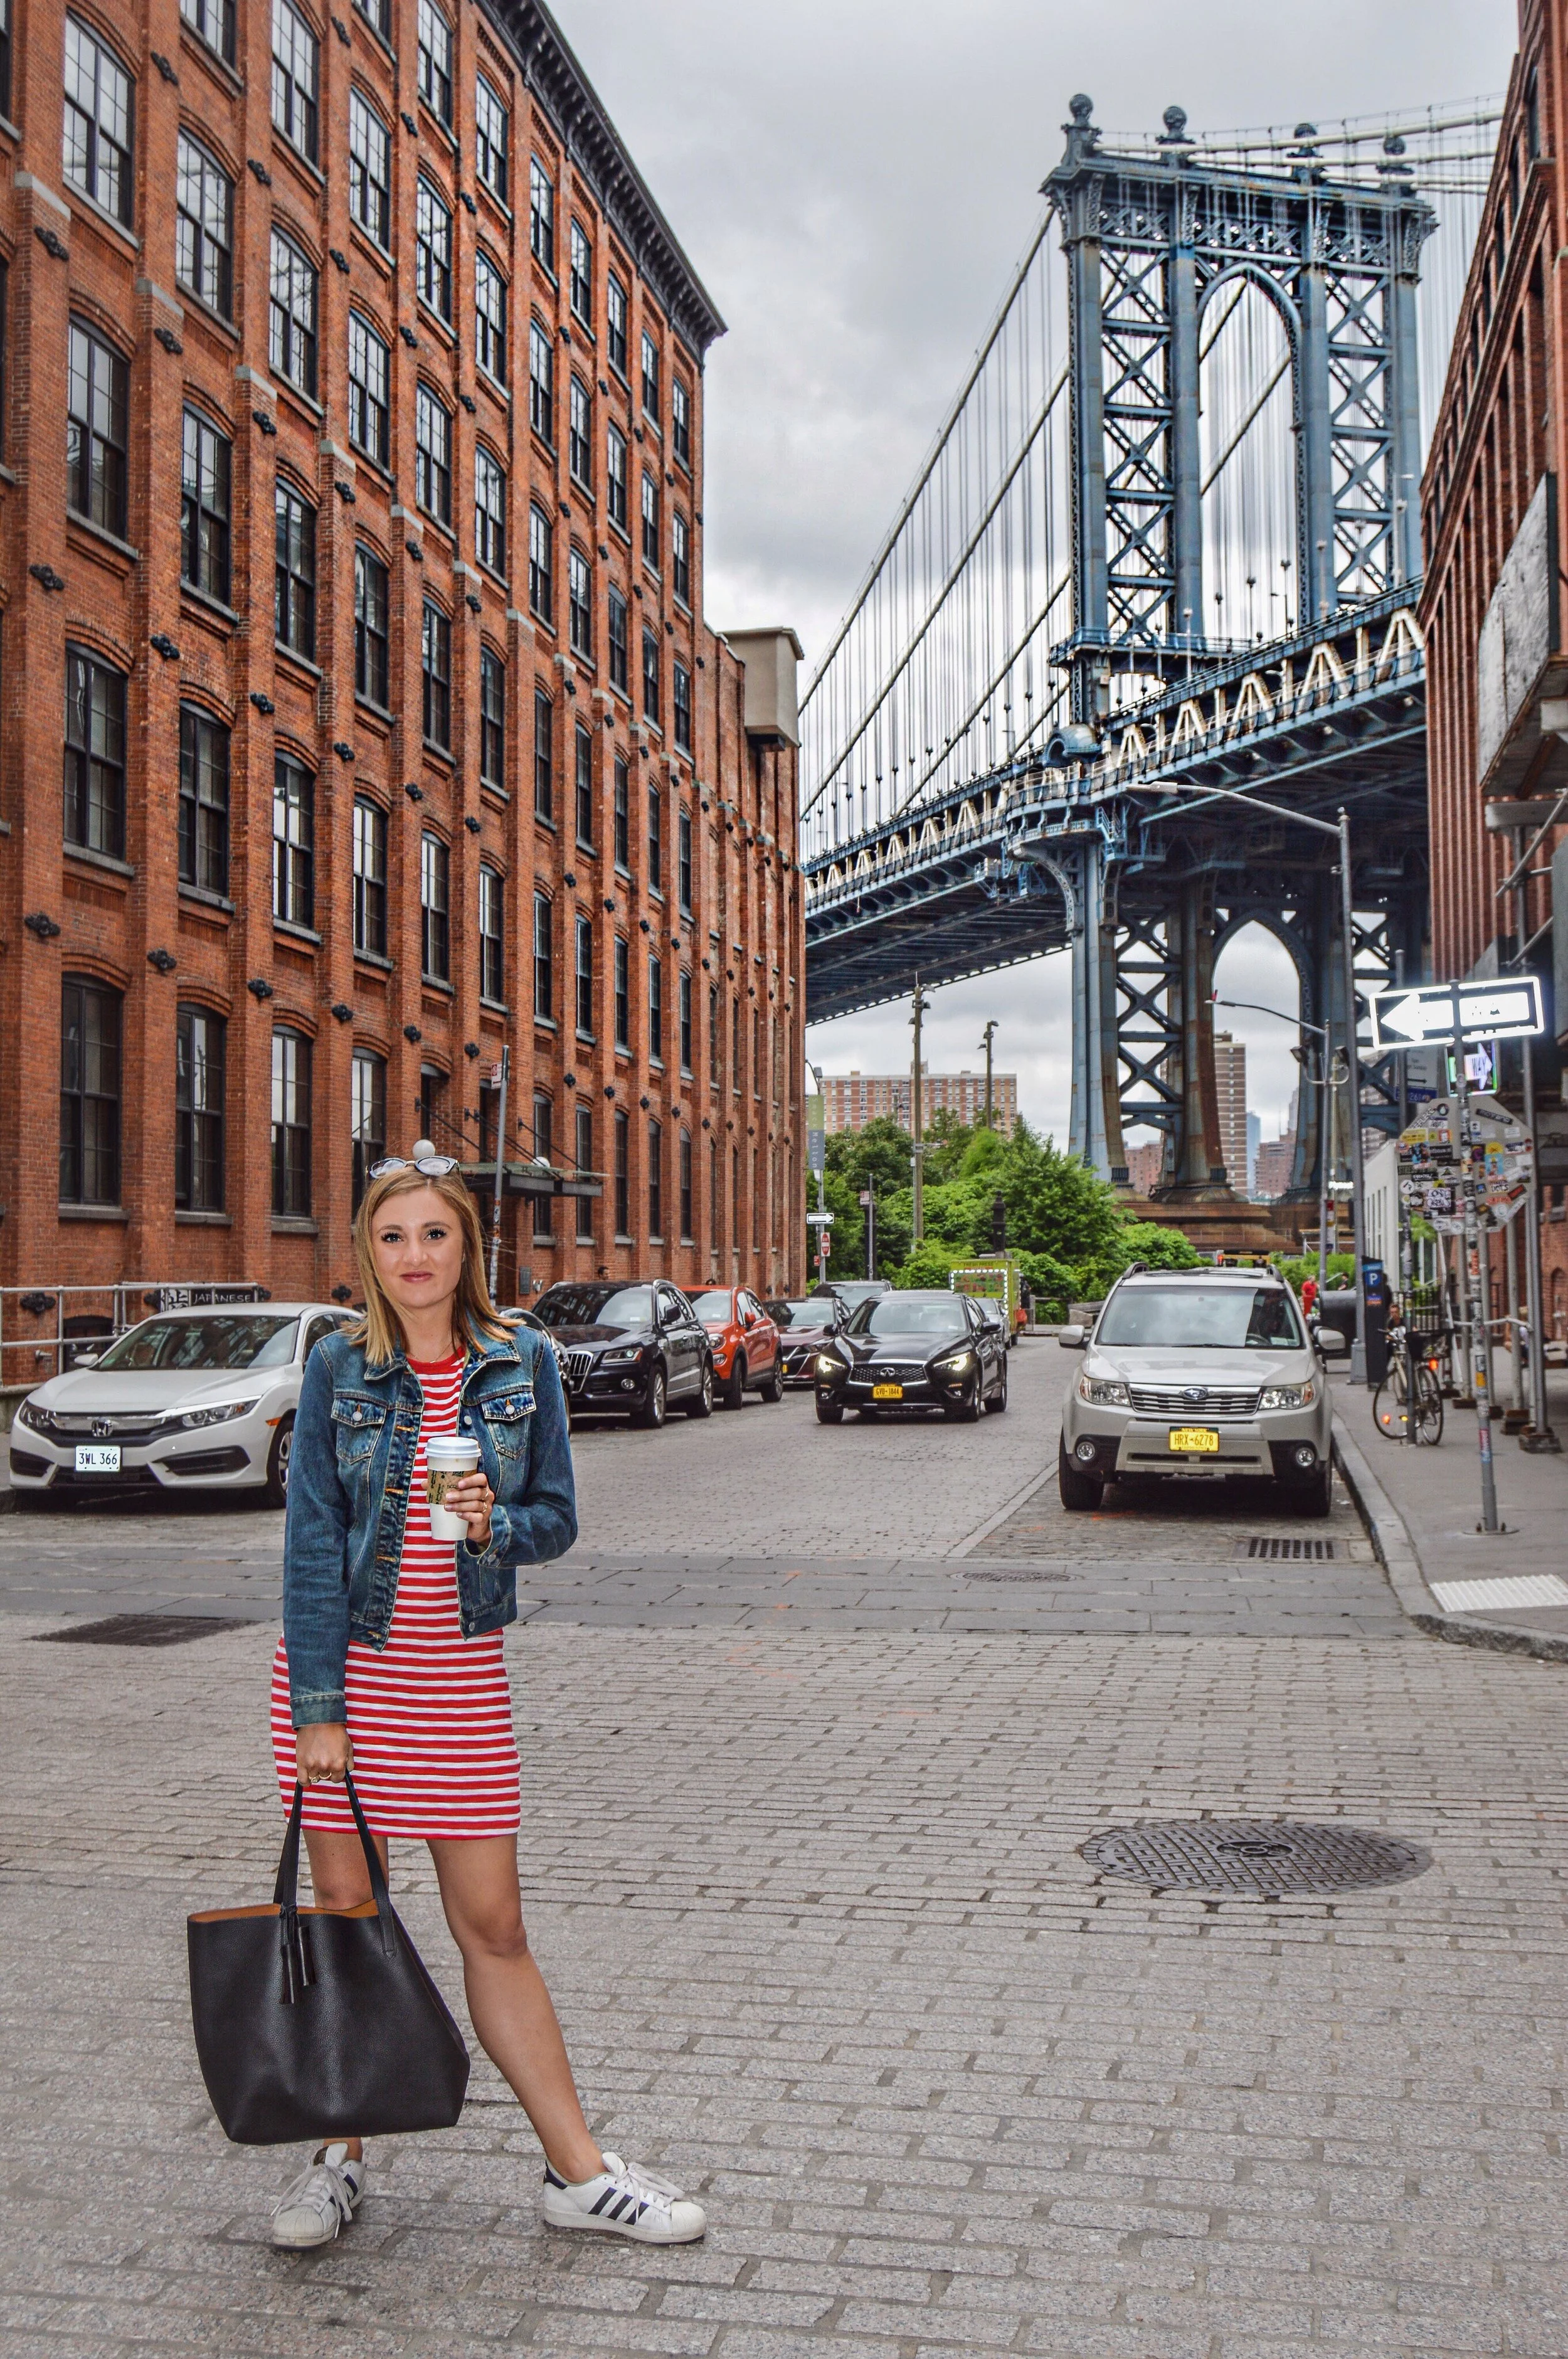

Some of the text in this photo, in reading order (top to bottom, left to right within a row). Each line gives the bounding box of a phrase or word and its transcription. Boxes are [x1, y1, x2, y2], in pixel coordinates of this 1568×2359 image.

[1370, 1273, 1379, 1285] P
[193, 1293, 251, 1305] JAPANESE
[79, 1453, 117, 1465] 3WL 366
